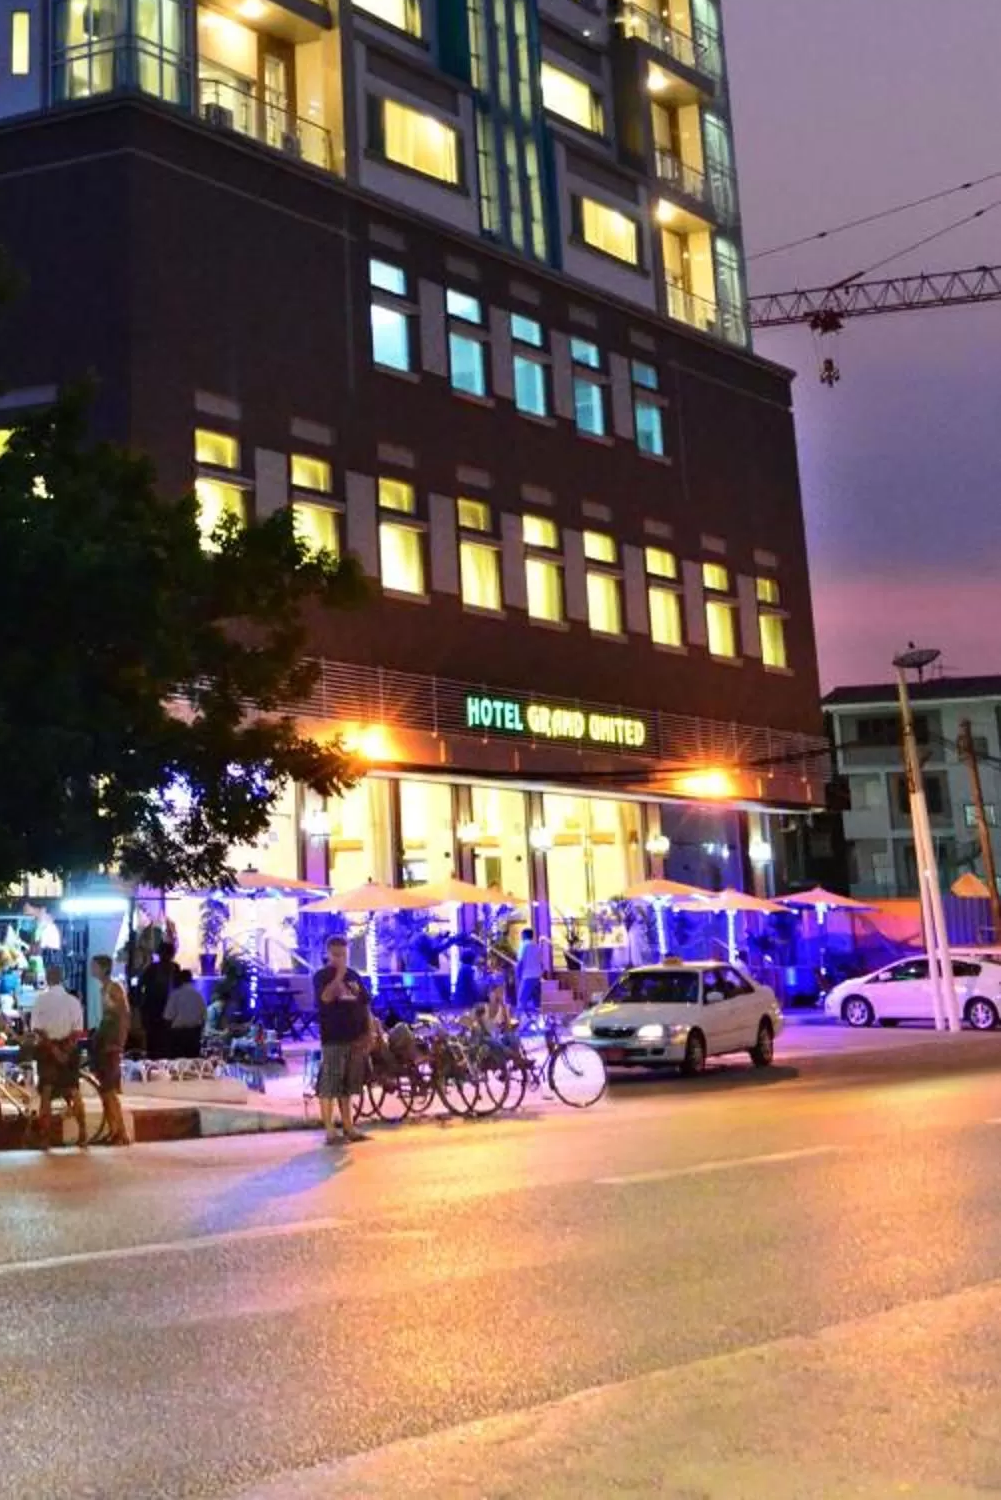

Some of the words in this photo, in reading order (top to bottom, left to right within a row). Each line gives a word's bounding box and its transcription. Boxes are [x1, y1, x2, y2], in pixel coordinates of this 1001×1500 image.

[467, 697, 523, 731] HOTEL
[527, 705, 585, 738] GRAND
[589, 713, 645, 746] UNITED
